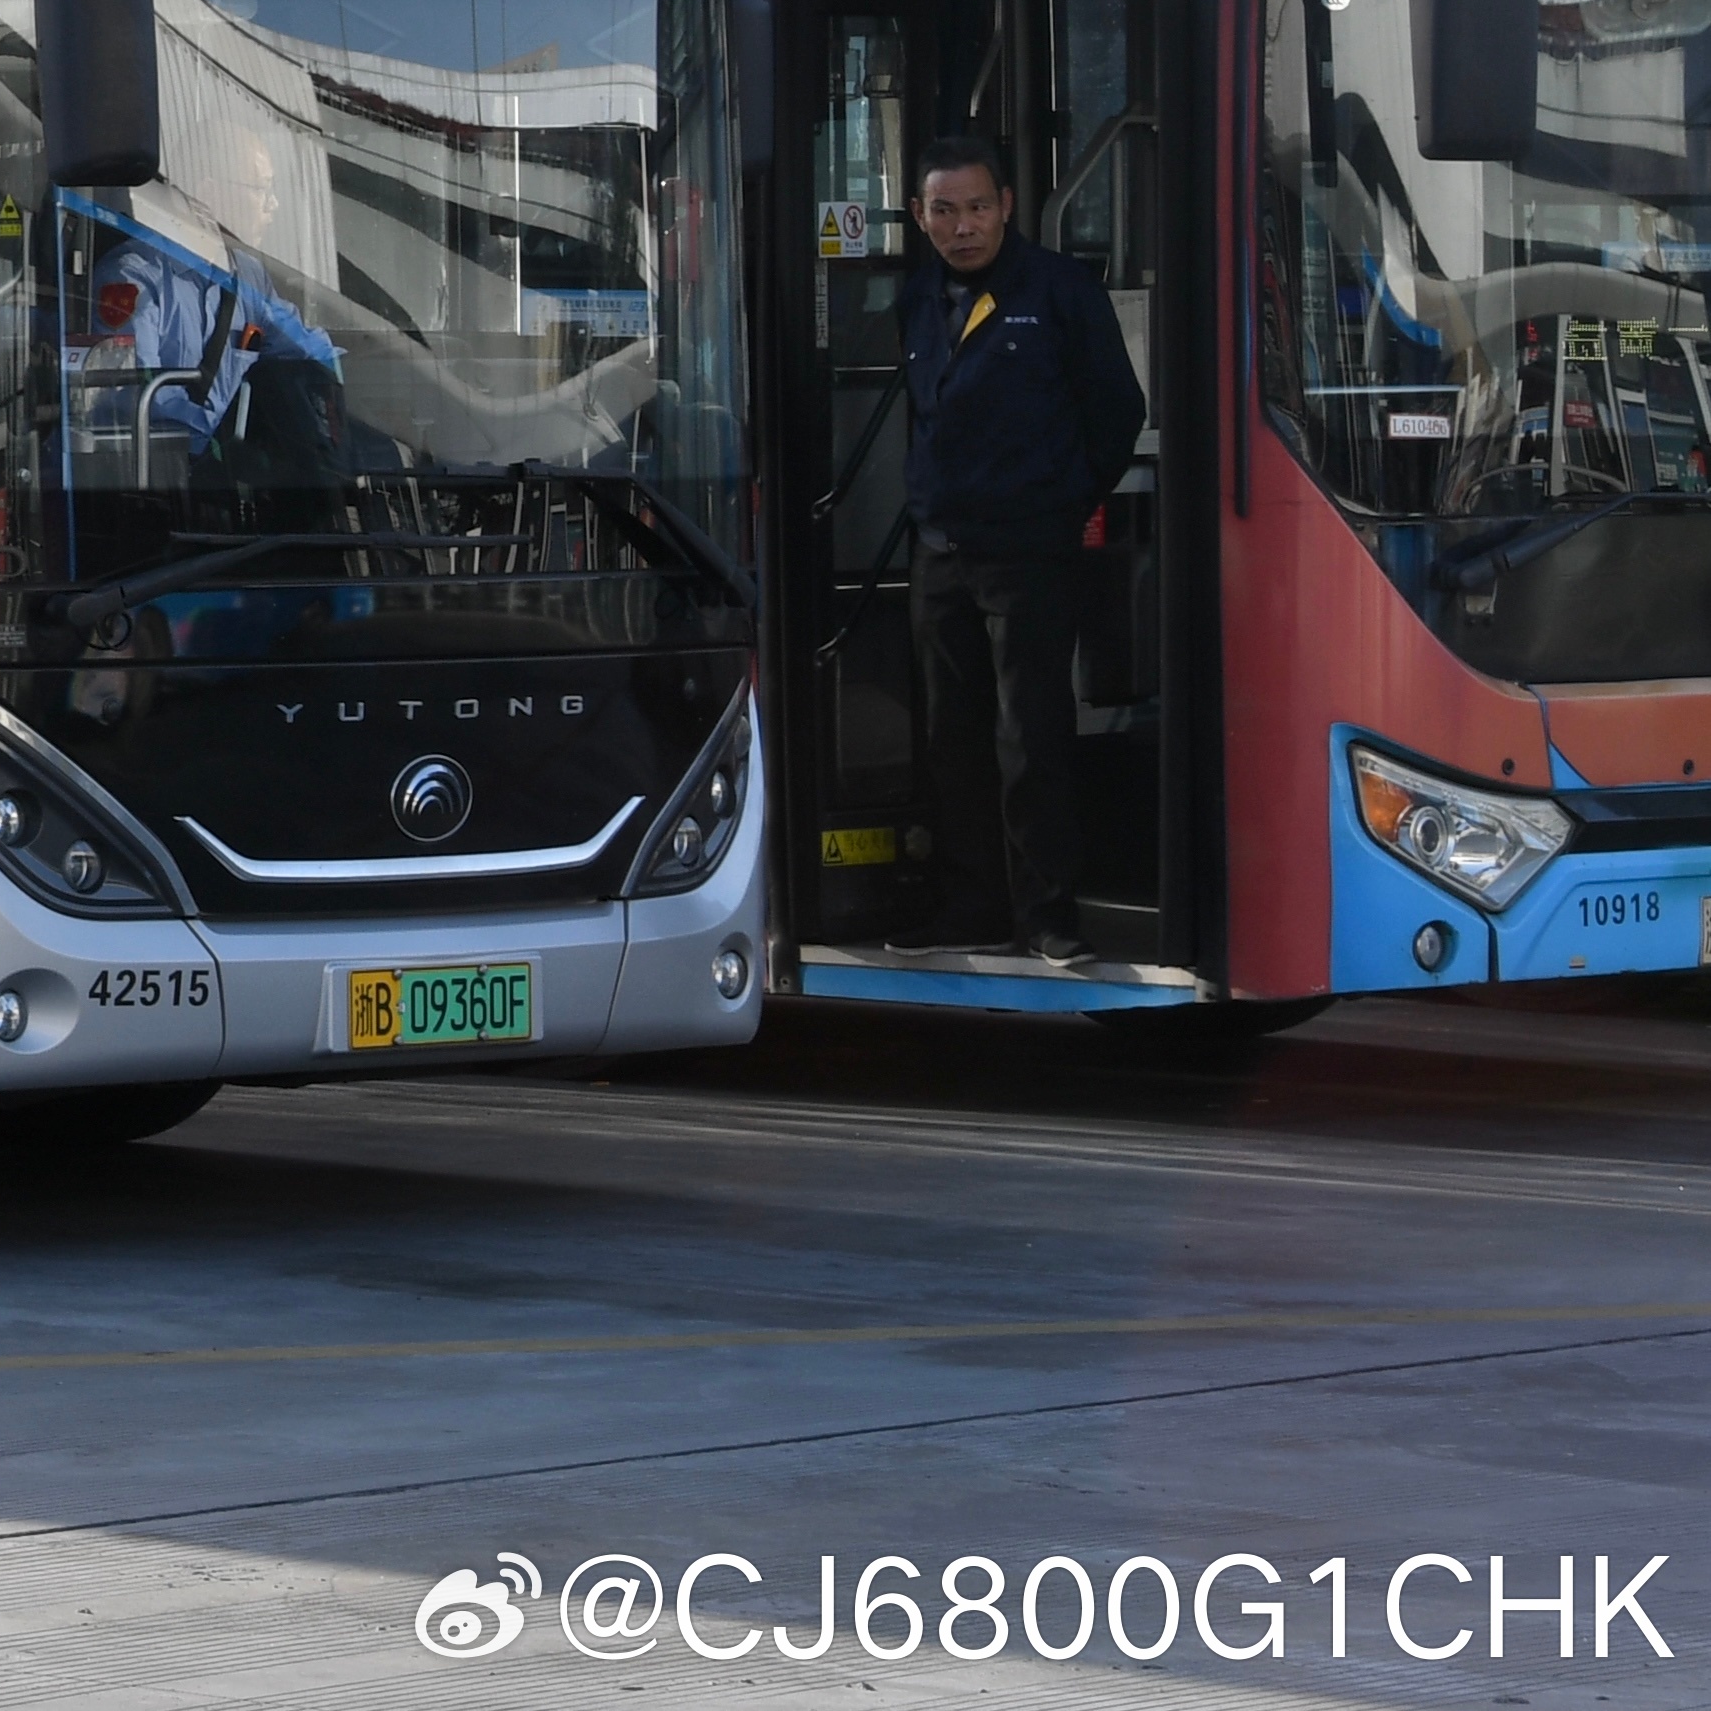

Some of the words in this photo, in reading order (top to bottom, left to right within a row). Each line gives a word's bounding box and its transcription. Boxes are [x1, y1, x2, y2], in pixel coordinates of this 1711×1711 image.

[277, 693, 586, 724] YUTONG
[1578, 891, 1661, 928] 10918
[88, 969, 211, 1008] 42515
